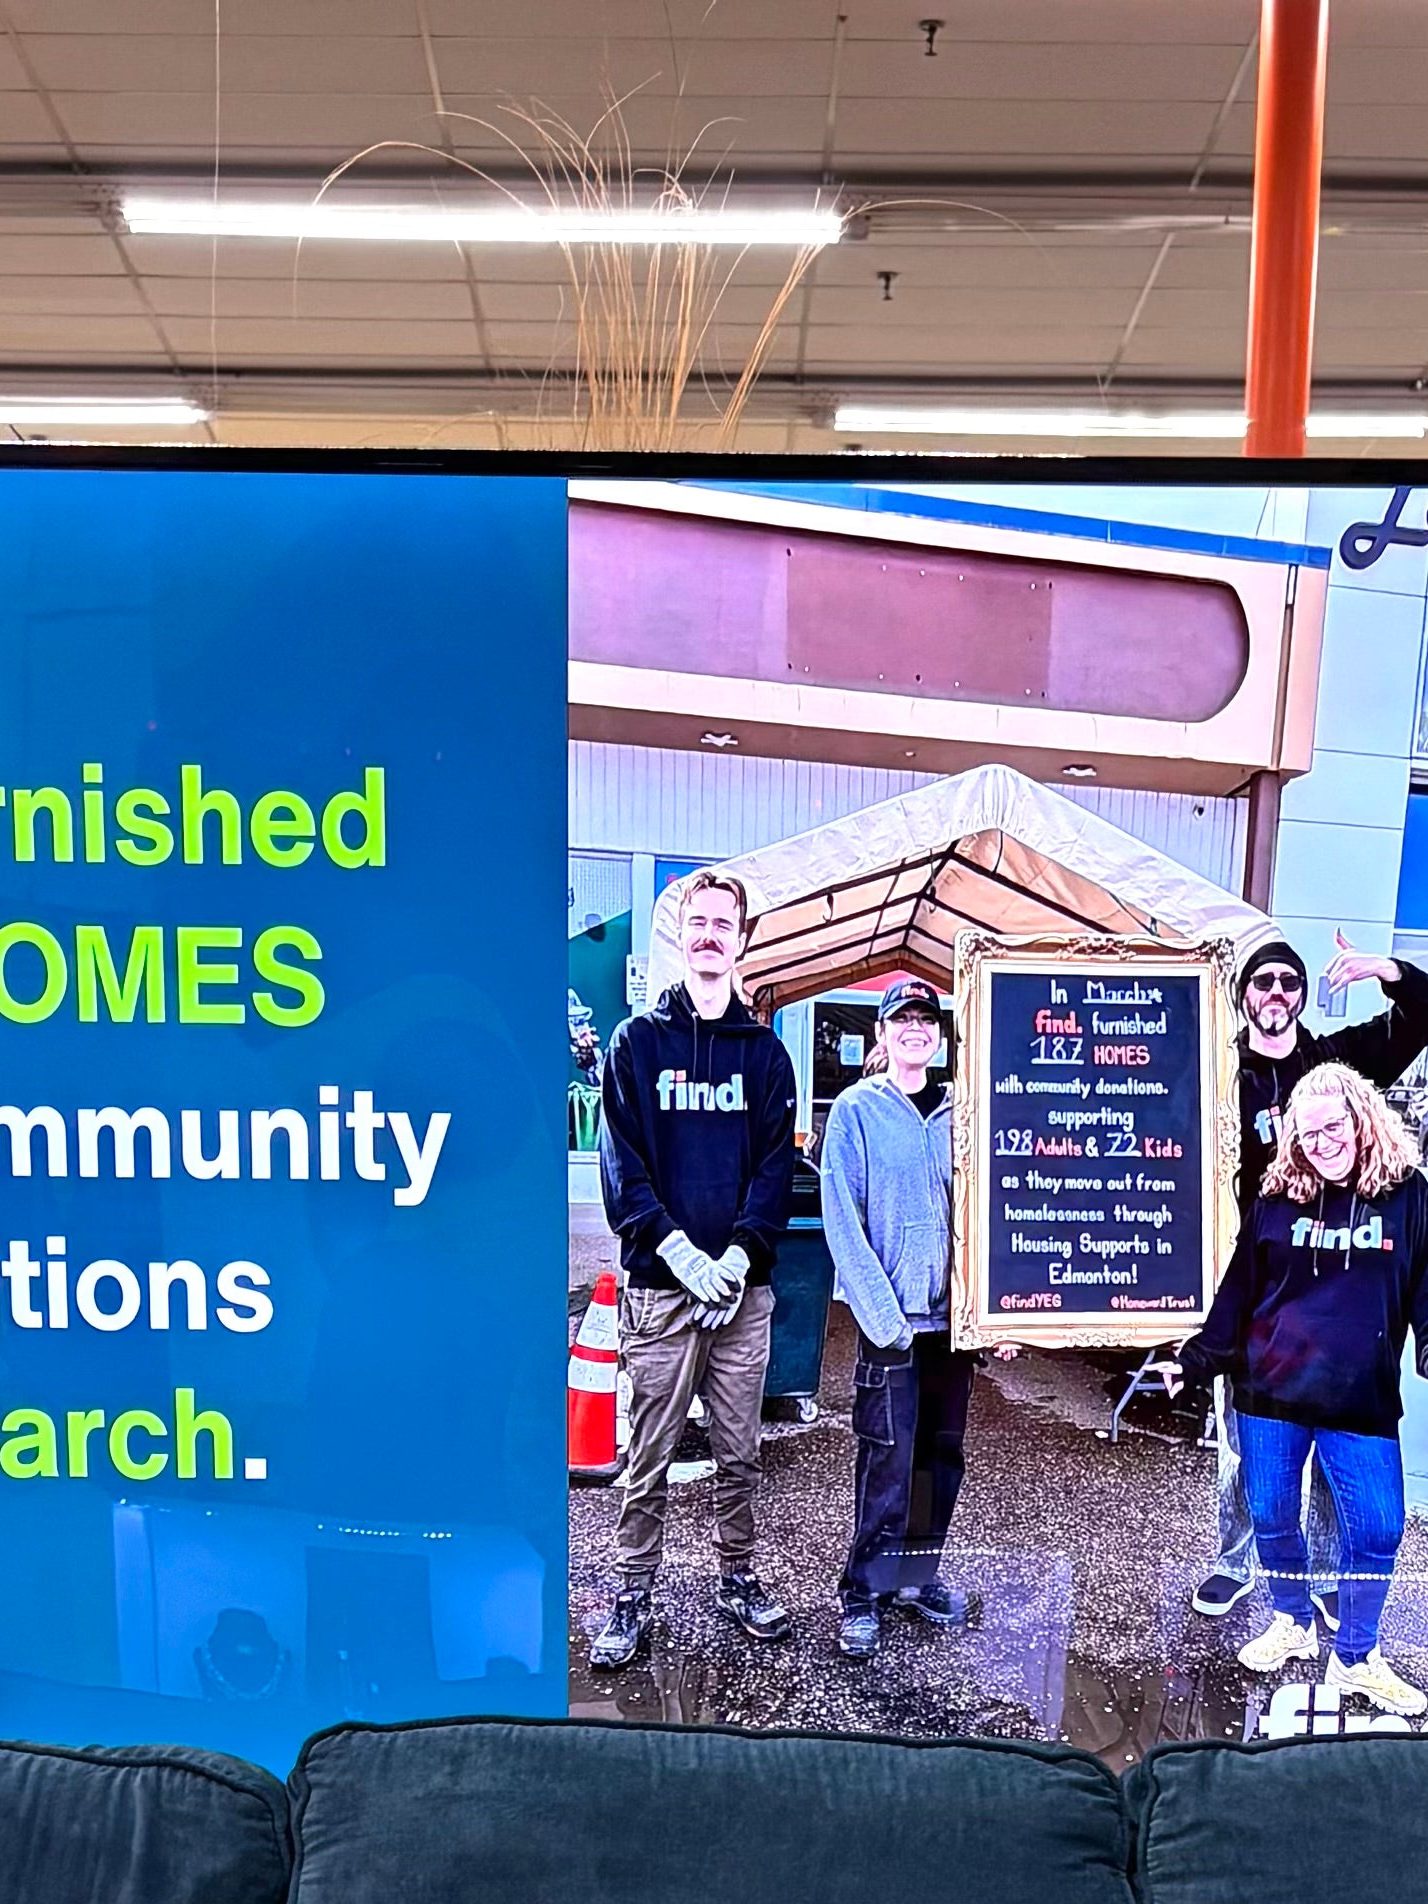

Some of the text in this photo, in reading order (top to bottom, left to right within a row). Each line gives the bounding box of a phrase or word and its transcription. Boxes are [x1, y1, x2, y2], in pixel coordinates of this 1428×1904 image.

[1051, 979, 1068, 1004] In
[1035, 1009, 1167, 1035] find. furnished
[1030, 1036, 1150, 1065] 187 HOMES
[995, 1074, 1169, 1099] with community donations.
[1048, 1106, 1134, 1132] supporting
[994, 1129, 1183, 1158] 198 Adults & 72 Kids
[1001, 1170, 1175, 1194] as they move out from
[1005, 1203, 1172, 1228] homelessness through
[1011, 1232, 1172, 1259] Housing Supports in
[1291, 1216, 1393, 1251] find.
[1049, 1263, 1138, 1284] Edmonton!
